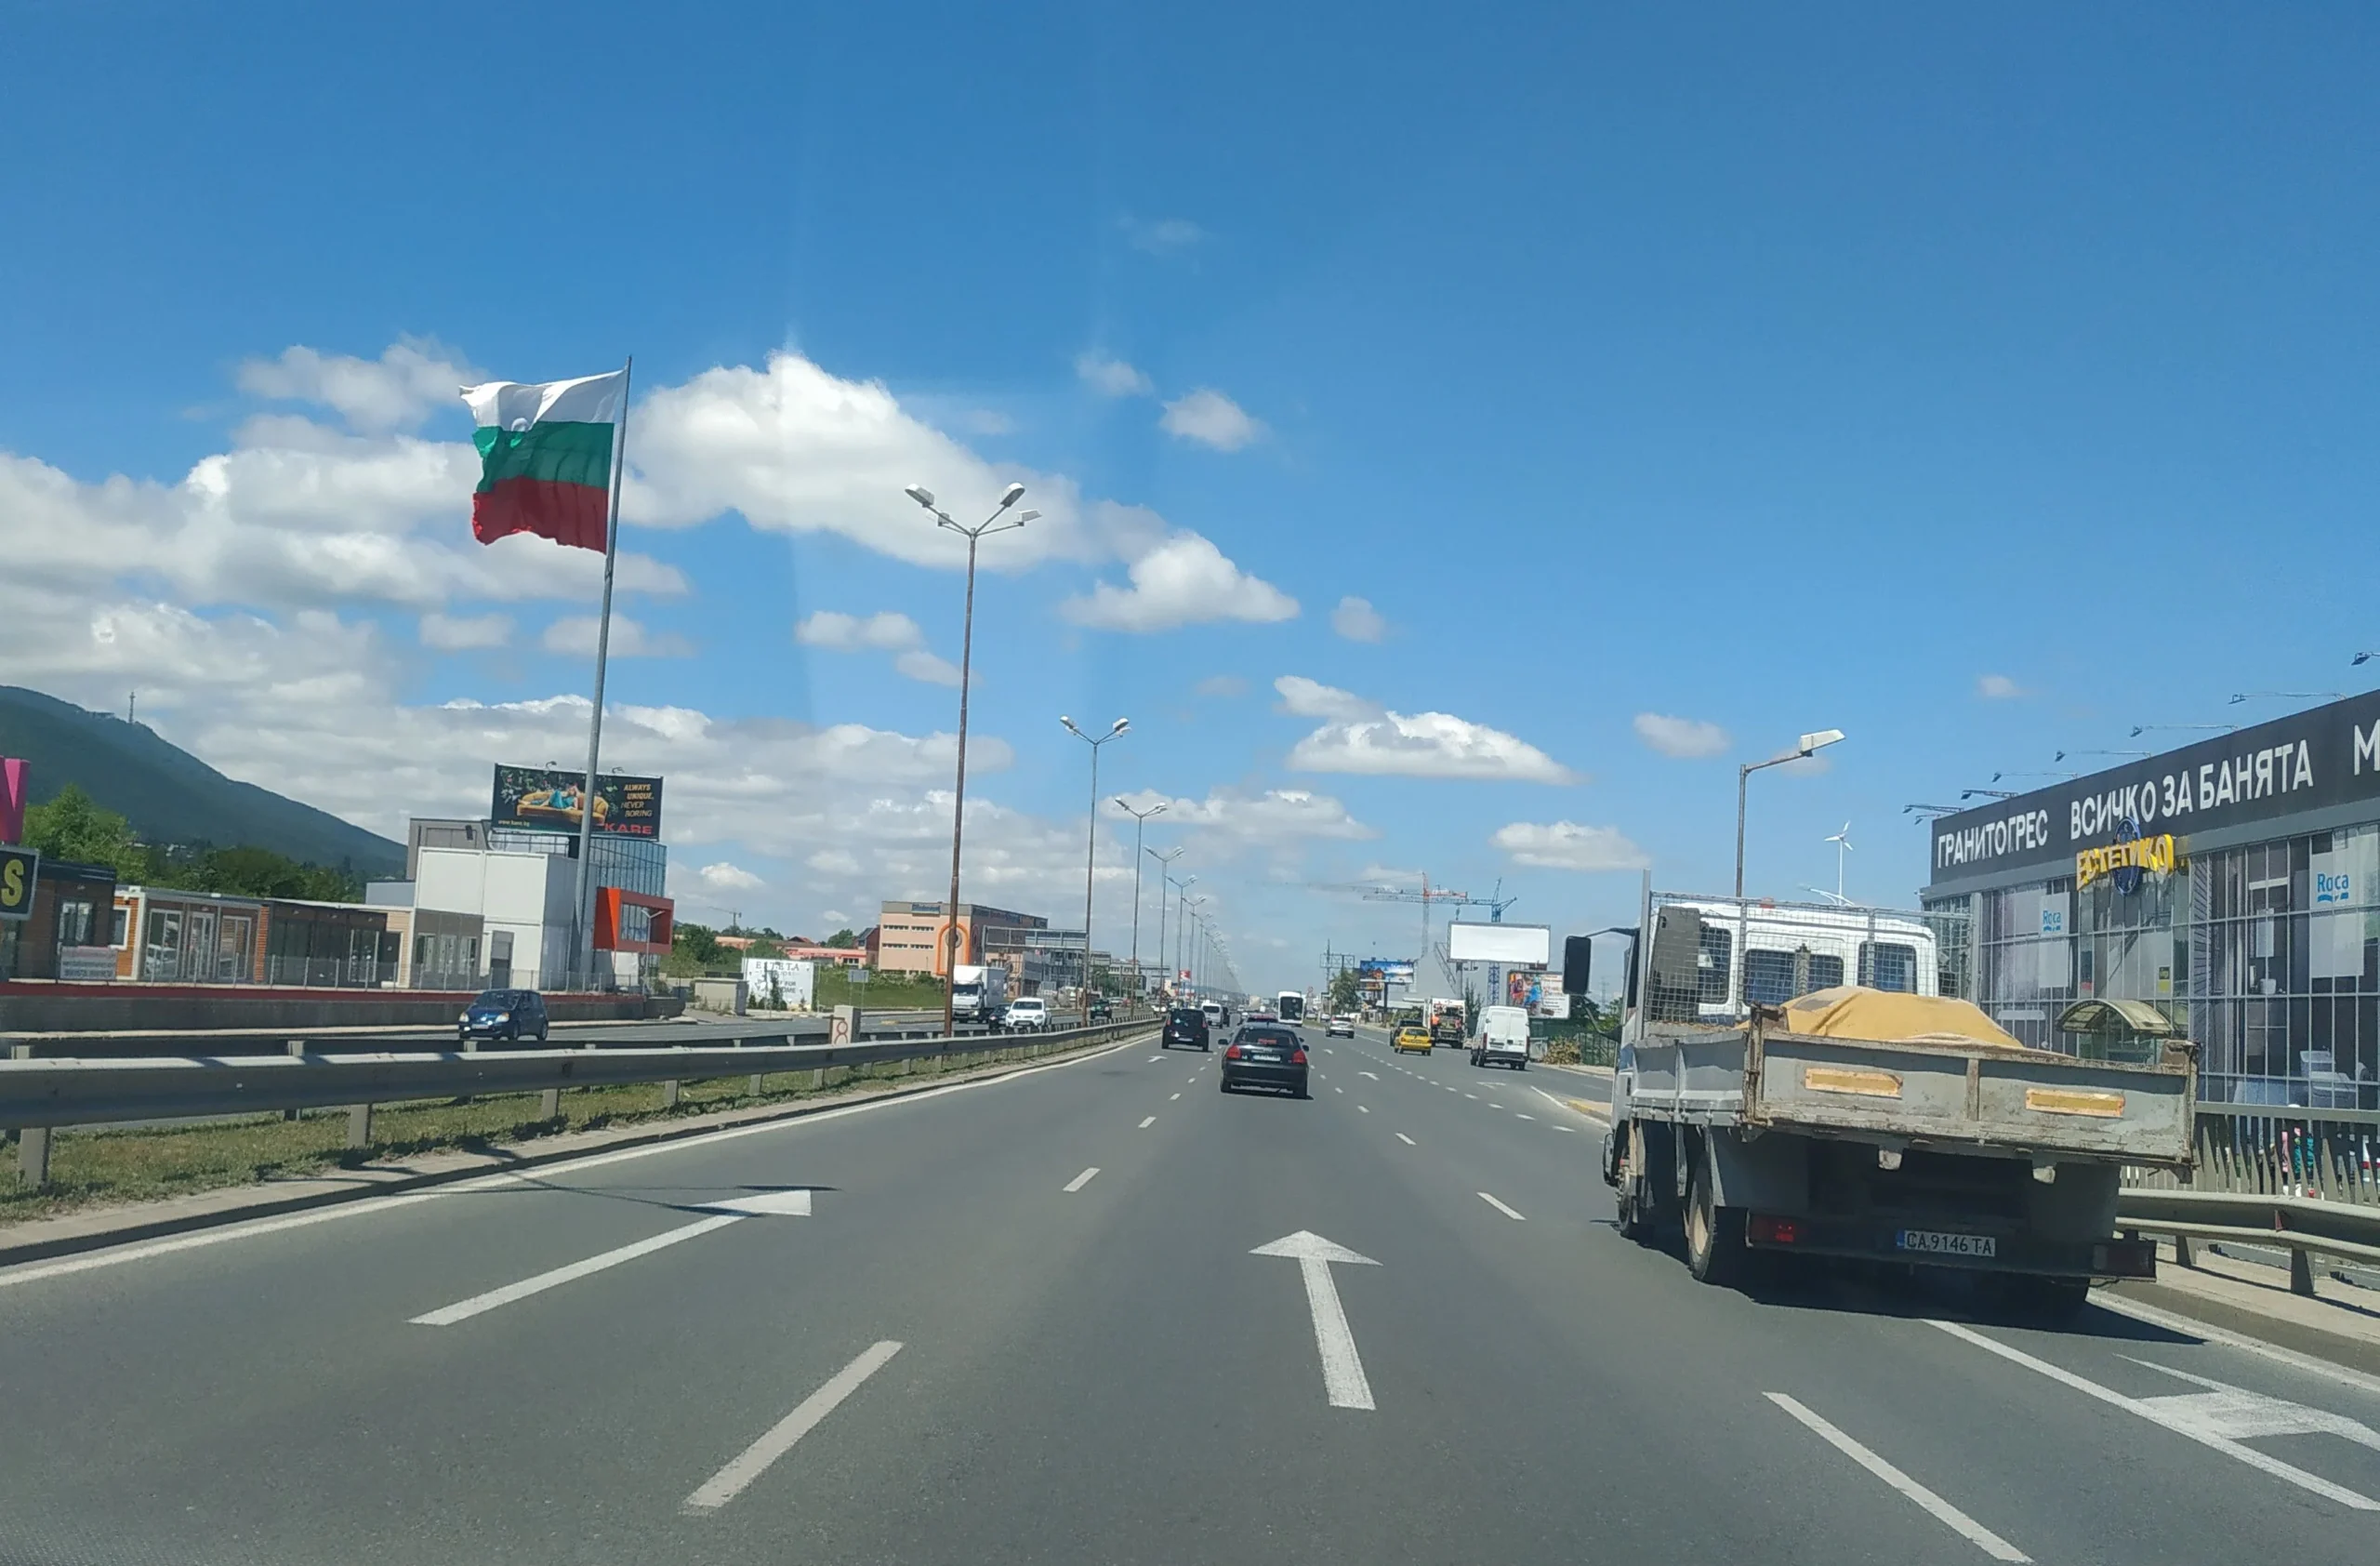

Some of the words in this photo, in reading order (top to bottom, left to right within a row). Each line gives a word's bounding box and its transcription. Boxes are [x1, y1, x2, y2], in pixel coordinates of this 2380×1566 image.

[2069, 780, 2157, 841] ВСИЧКО
[2162, 770, 2193, 817] ЗА
[2199, 738, 2314, 810] БАНЯТА
[621, 801, 644, 809] NEVER
[604, 822, 654, 835] KARE
[1937, 808, 2049, 869] ГРАНИТОГРЕС
[2076, 833, 2175, 891] ЕСТЕТИКО
[2317, 873, 2349, 893] Roca
[2043, 909, 2061, 924] Roca
[756, 961, 800, 972] ETETA
[1906, 1232, 1926, 1249] CA
[1930, 1234, 1969, 1253] 9146
[1972, 1238, 1992, 1254] TA
